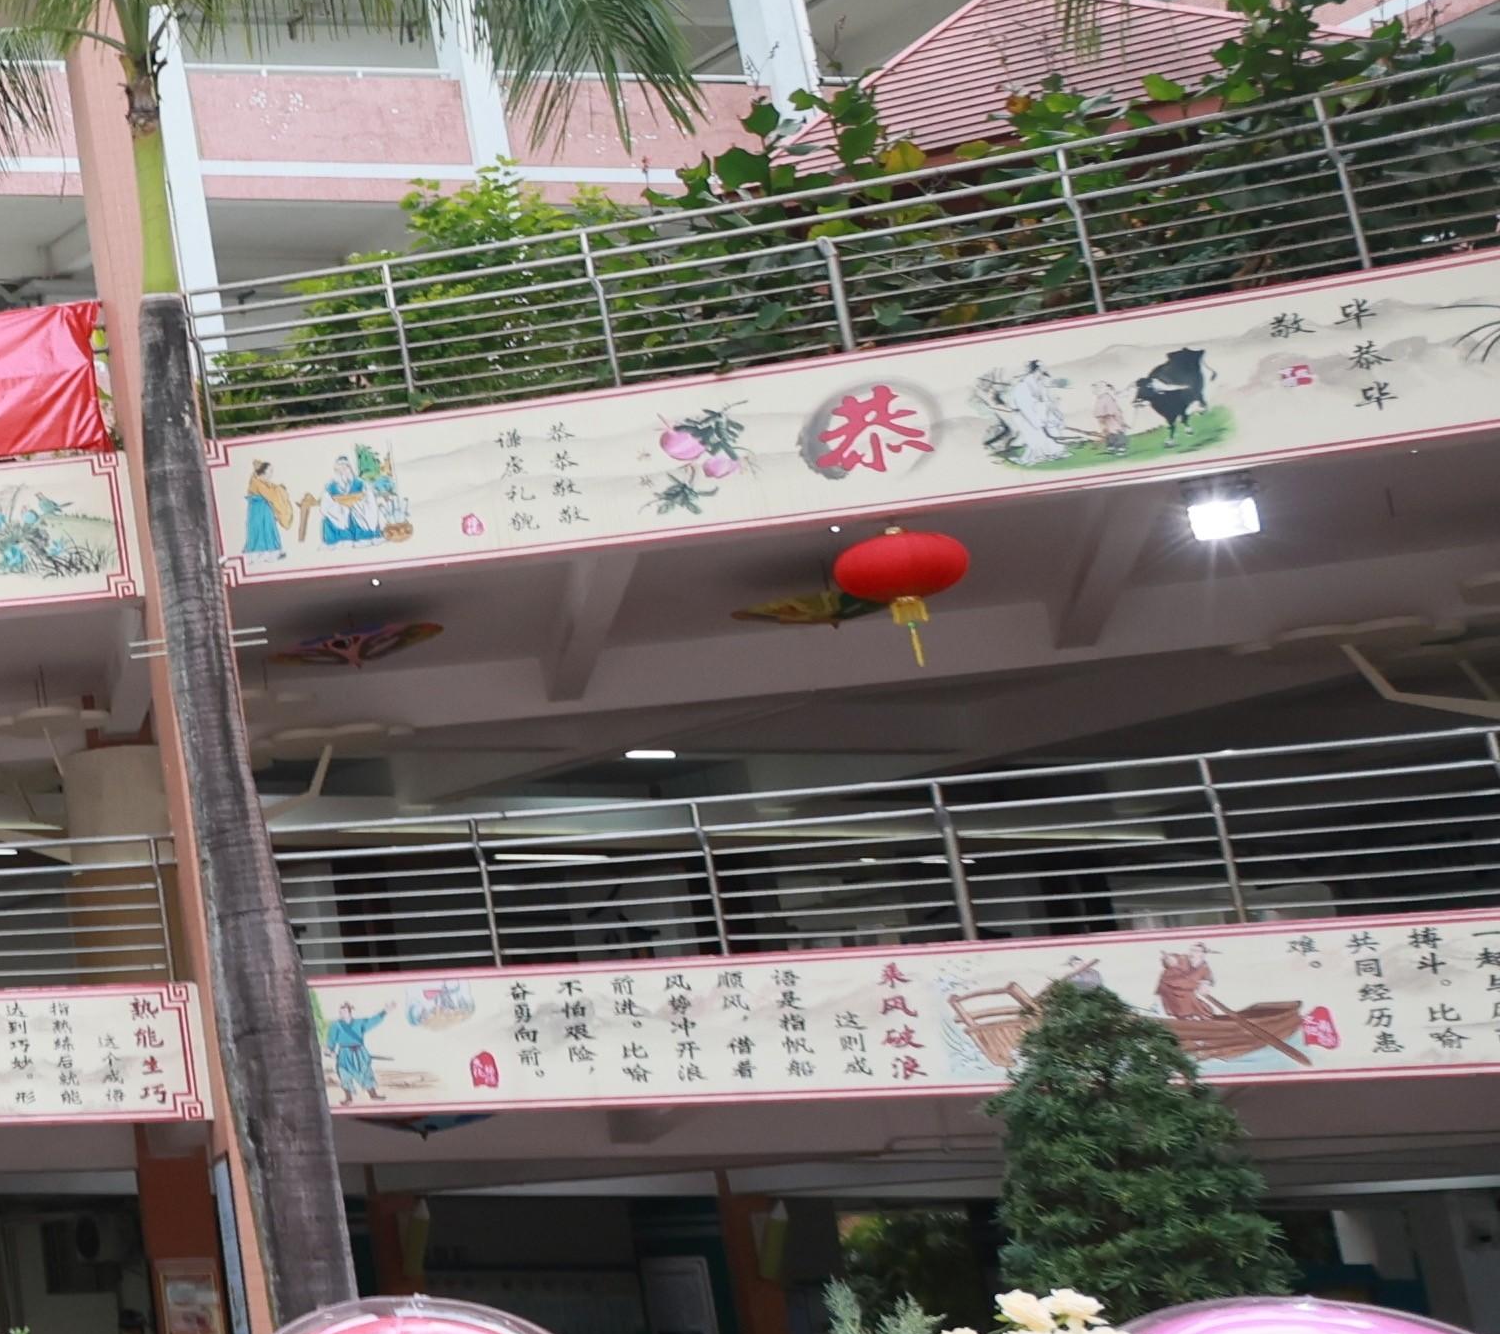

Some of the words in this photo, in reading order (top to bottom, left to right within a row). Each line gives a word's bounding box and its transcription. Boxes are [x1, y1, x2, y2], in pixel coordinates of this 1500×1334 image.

[1269, 312, 1317, 339] 敬
[1334, 298, 1399, 411] 毕恭毕
[816, 382, 937, 476] 恭
[771, 969, 818, 1078] 语是指帆船
[834, 1011, 875, 1076] 这则成
[877, 962, 929, 1081] 乘风破浪
[1346, 931, 1405, 1054] 共同经历患
[129, 997, 167, 1104] 熟能生巧
